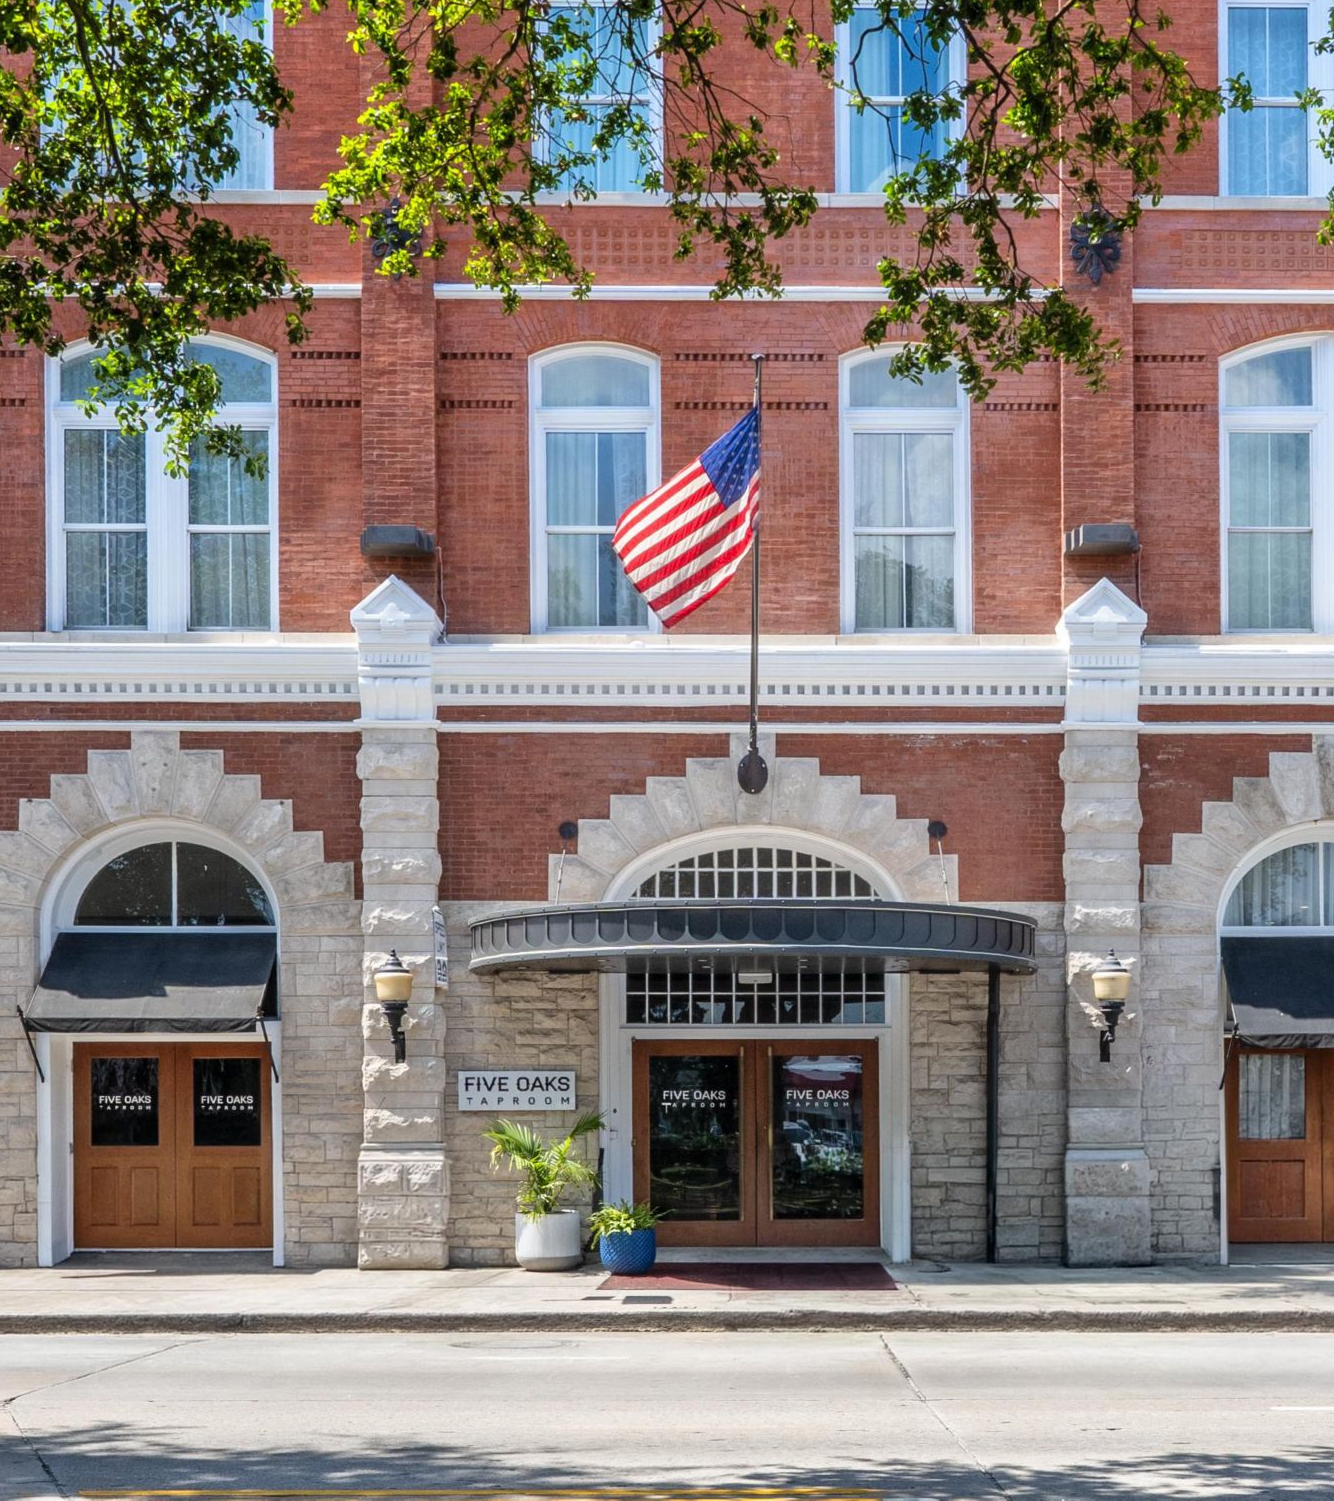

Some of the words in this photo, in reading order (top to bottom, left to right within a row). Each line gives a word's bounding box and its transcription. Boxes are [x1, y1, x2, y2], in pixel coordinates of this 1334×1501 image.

[464, 1076, 509, 1092] FIVE
[516, 1076, 570, 1092] OAKS
[98, 1095, 122, 1104] FIVE
[124, 1095, 152, 1104] OAKS
[200, 1095, 224, 1104] FIVE
[226, 1095, 254, 1104] OAKS
[662, 1090, 690, 1100] FIVE
[693, 1090, 726, 1100] OAKS
[786, 1089, 813, 1100] FIVE
[816, 1089, 849, 1100] OAKS
[466, 1096, 570, 1106] TAPROOM
